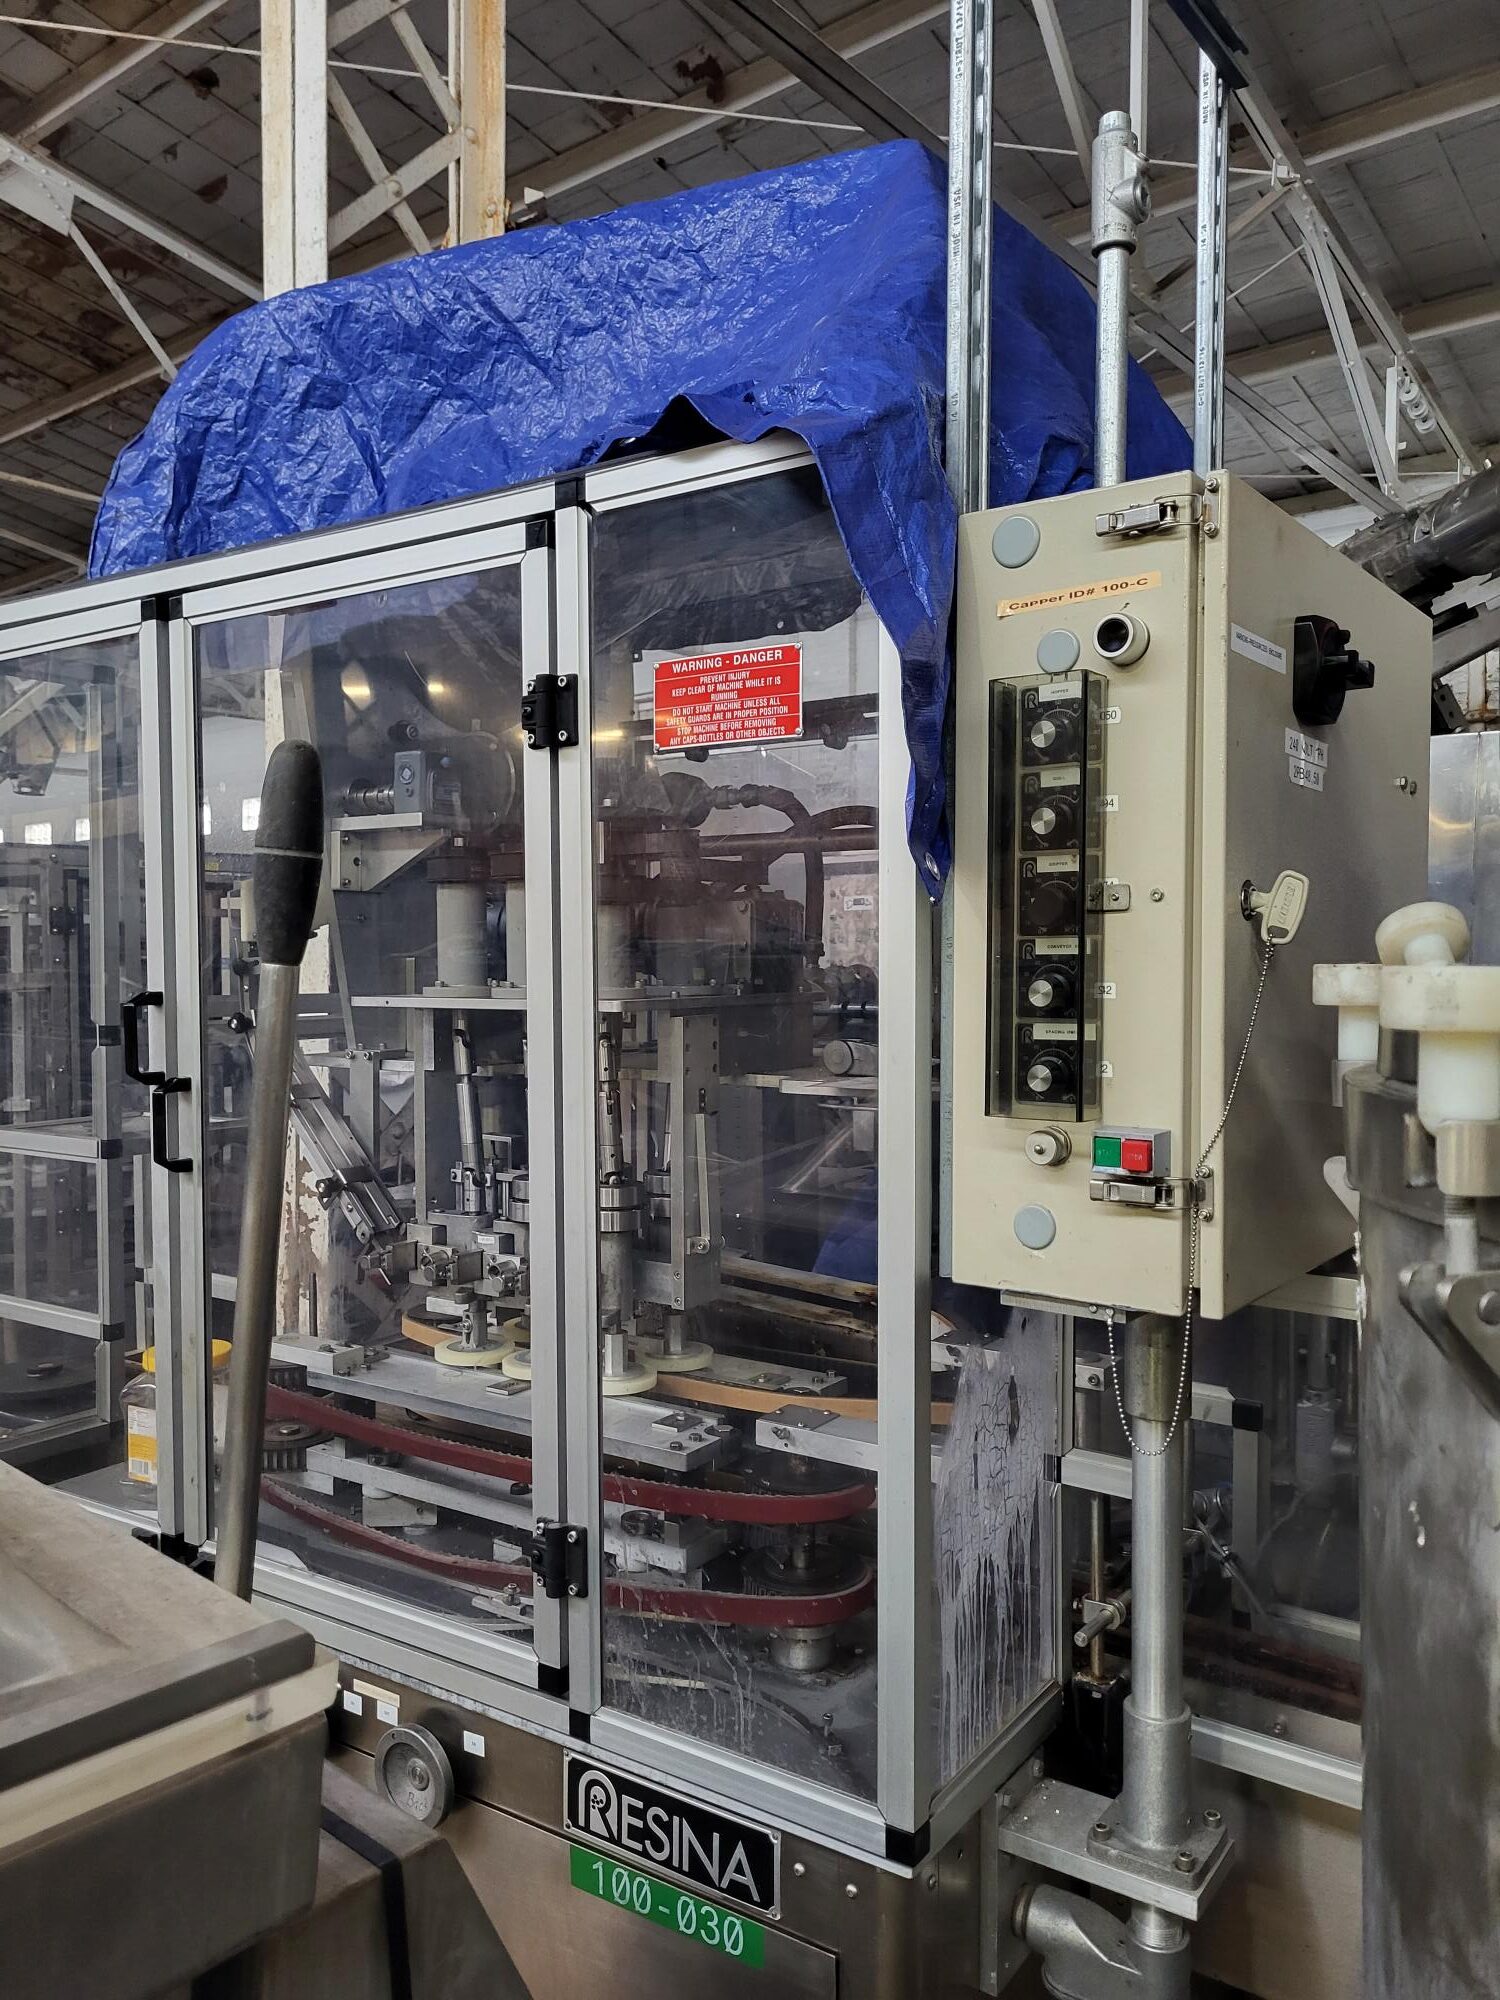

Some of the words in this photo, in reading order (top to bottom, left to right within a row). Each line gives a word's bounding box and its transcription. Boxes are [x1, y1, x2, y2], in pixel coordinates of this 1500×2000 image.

[953, 188, 961, 209] USA
[953, 213, 961, 226] IN
[952, 232, 961, 258] MADE
[1008, 595, 1065, 610] Capper
[1069, 587, 1095, 599] ID#
[1101, 578, 1149, 593] 100-C
[672, 657, 722, 673] WARNING
[733, 650, 783, 665] DANGER
[672, 687, 687, 697] KEEP
[687, 685, 706, 695] CLEAR
[707, 684, 716, 693] OF
[716, 681, 744, 692] MACHINE
[745, 678, 765, 688] WHILE
[766, 677, 773, 686] IT
[774, 676, 781, 685] IS
[700, 673, 726, 684] PREVENT
[728, 671, 750, 681] INJURY
[710, 691, 738, 701] RUNNING
[666, 715, 687, 726] SAFETY
[687, 713, 711, 724] GUARDS
[712, 711, 724, 721] ARE
[725, 711, 732, 720] IN
[733, 708, 758, 719] PROPER
[759, 705, 788, 716] POSITION
[672, 708, 681, 717] DO
[682, 706, 694, 715] NOT
[695, 704, 713, 714] START
[714, 701, 742, 712] MACHINE
[743, 698, 768, 708] UNLESS
[769, 697, 781, 706] ALL
[669, 736, 682, 745] ANY
[682, 731, 724, 744] CAPS-BOTTLES
[725, 730, 734, 739] OR
[735, 728, 756, 738] OTHER
[757, 726, 785, 737] OBJECTS
[677, 726, 692, 736] STOP
[693, 723, 719, 734] MACHINE
[720, 720, 743, 731] BEFORE
[744, 717, 777, 728] REMOVING
[578, 1769, 761, 1903] RESINA
[592, 1861, 744, 1956] 100-030
